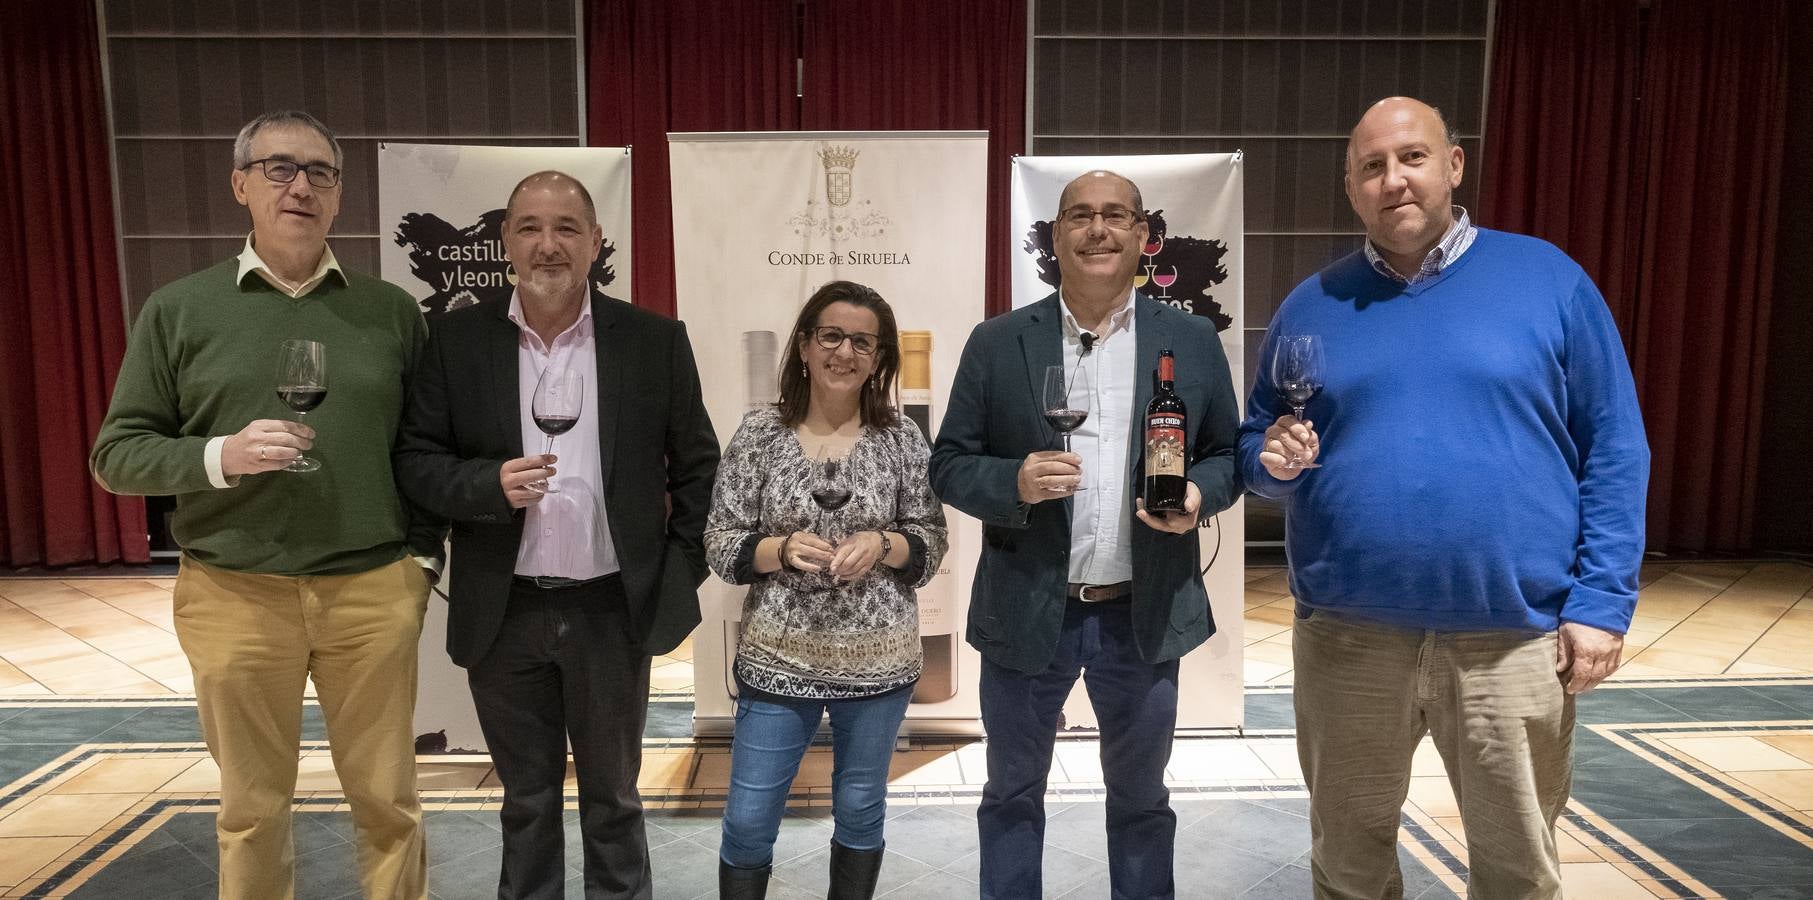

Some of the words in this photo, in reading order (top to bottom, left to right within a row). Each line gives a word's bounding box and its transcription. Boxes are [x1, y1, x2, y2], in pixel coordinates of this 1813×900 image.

[768, 251, 825, 266] CONDE
[848, 250, 911, 265] SIRUELA
[441, 271, 455, 293] y
[457, 265, 503, 288] leon
